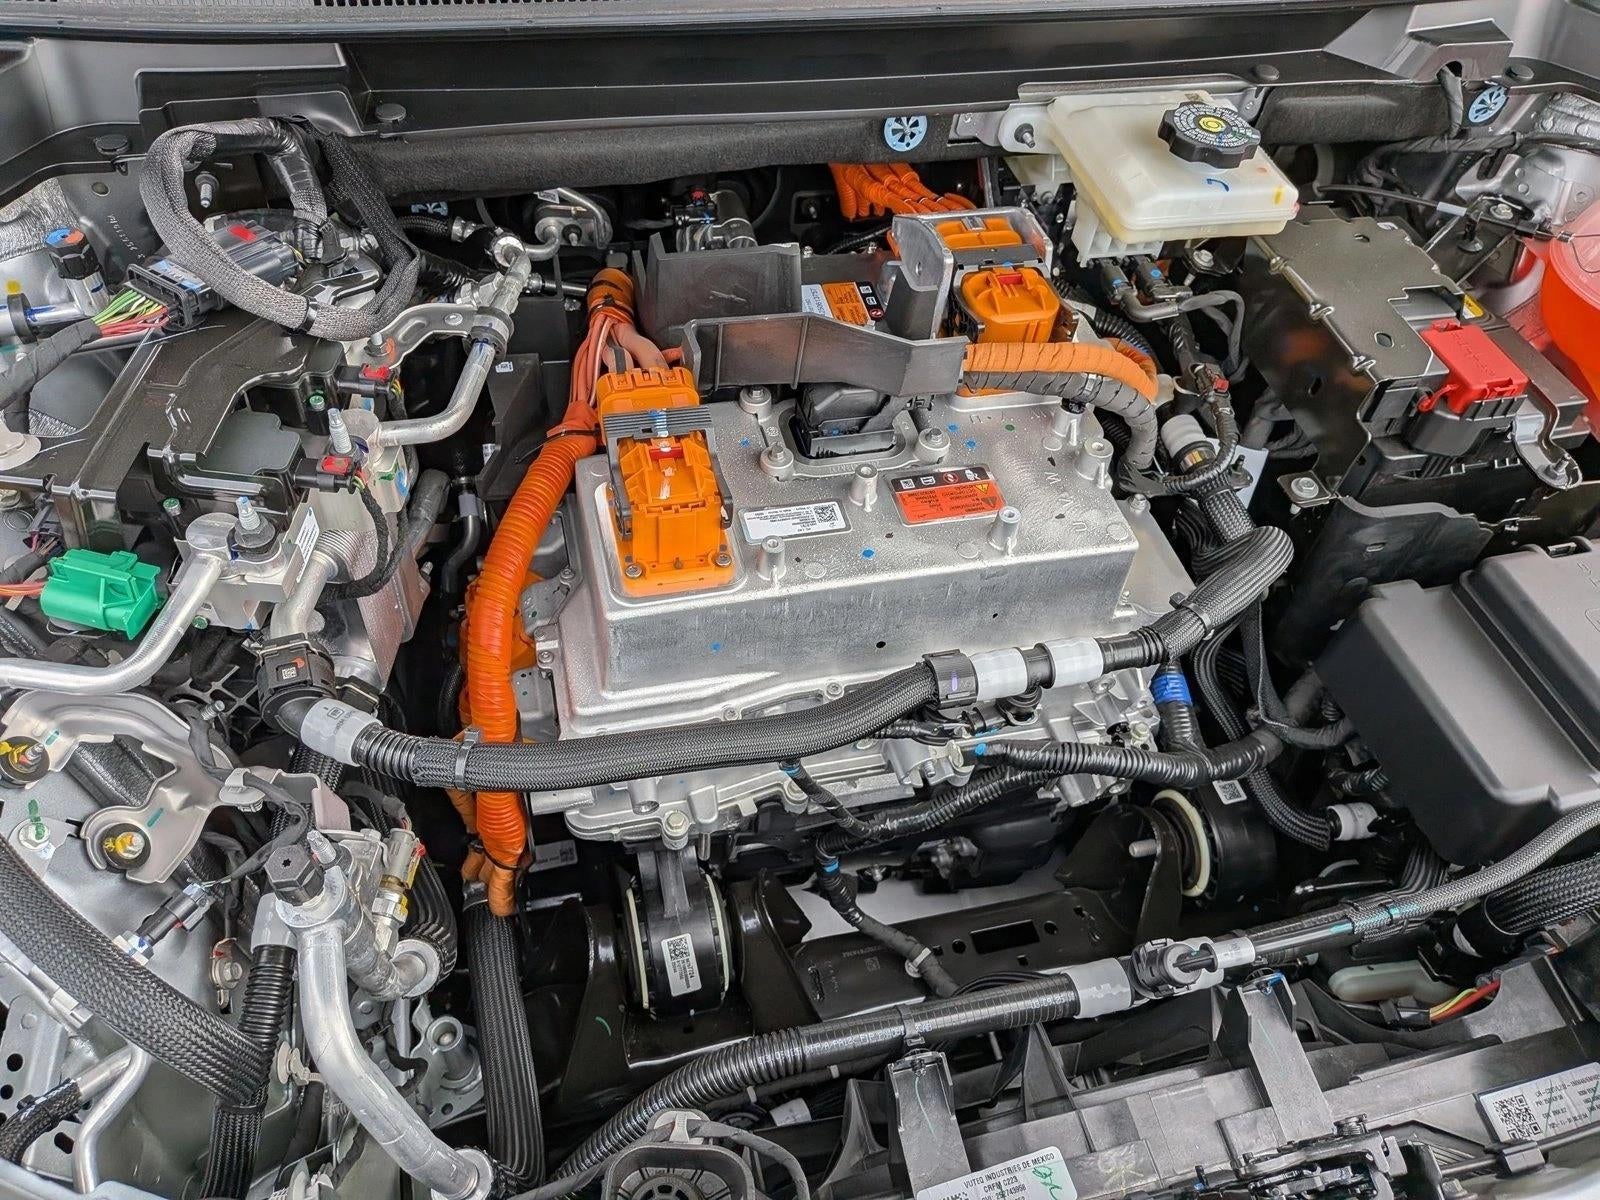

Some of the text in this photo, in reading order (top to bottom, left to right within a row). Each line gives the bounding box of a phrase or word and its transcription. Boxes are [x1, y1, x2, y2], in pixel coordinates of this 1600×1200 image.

[963, 1151, 1056, 1190] VUTEQ INDUSTRIES DE MEXICO
[1003, 1174, 1020, 1187] C223
